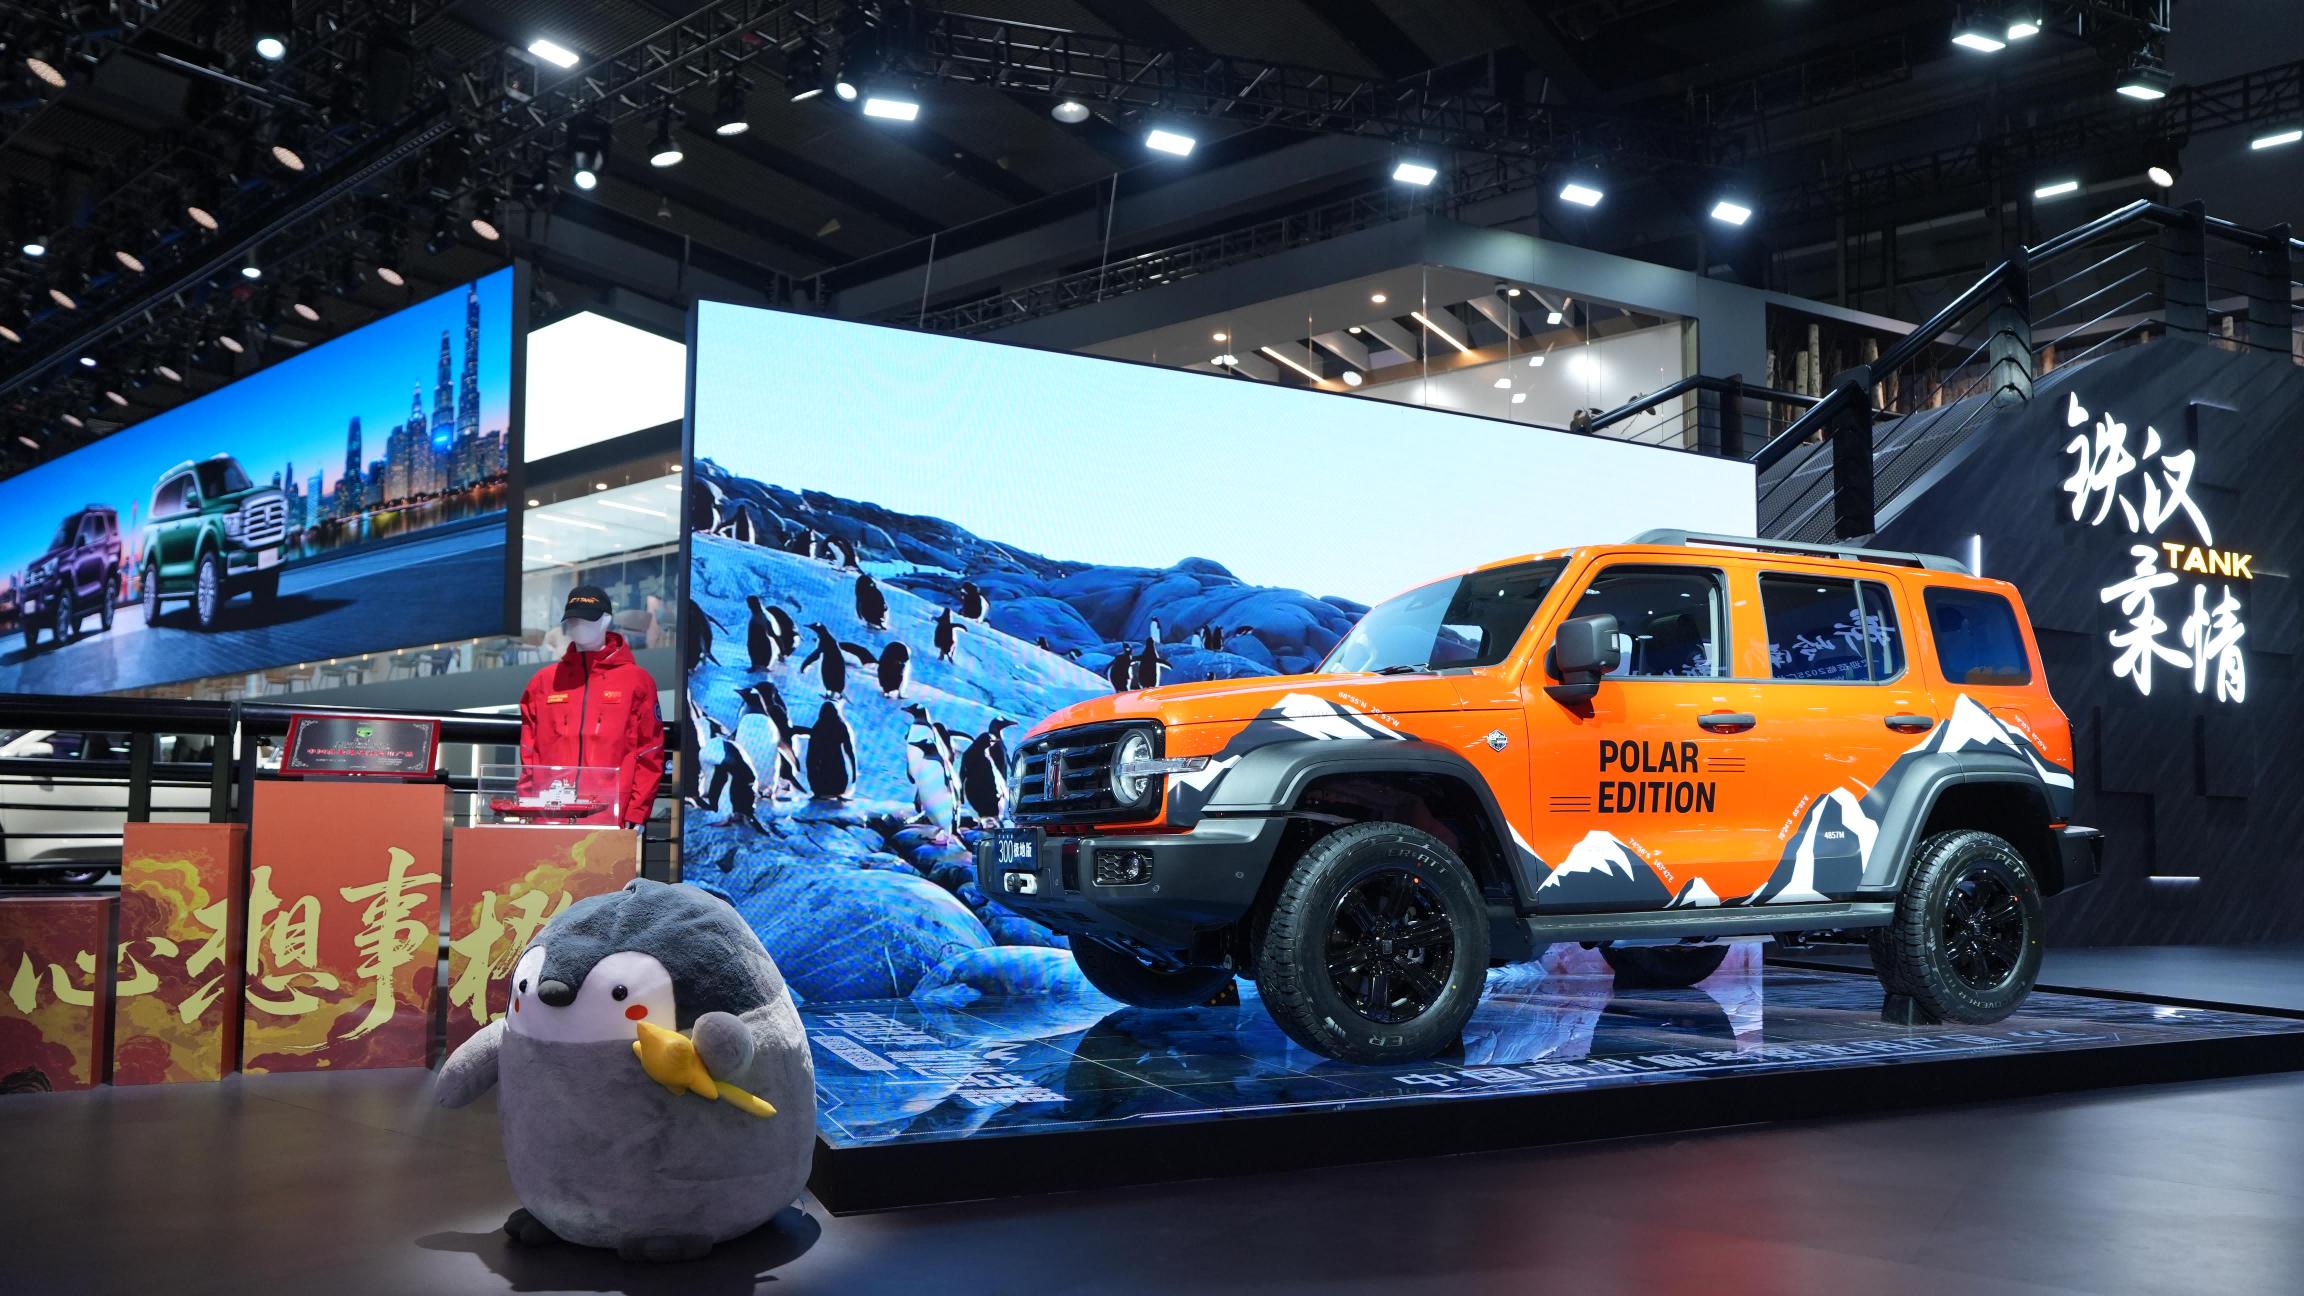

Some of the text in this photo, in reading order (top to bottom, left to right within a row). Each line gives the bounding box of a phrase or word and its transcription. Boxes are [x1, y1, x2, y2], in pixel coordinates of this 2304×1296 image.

[2063, 391, 2212, 547] 铁汉
[2162, 541, 2254, 580] TANK
[2100, 544, 2247, 704] 柔情
[1600, 740, 1699, 773] POLAR
[1598, 781, 1716, 813] EDITION
[998, 840, 1013, 863] 300
